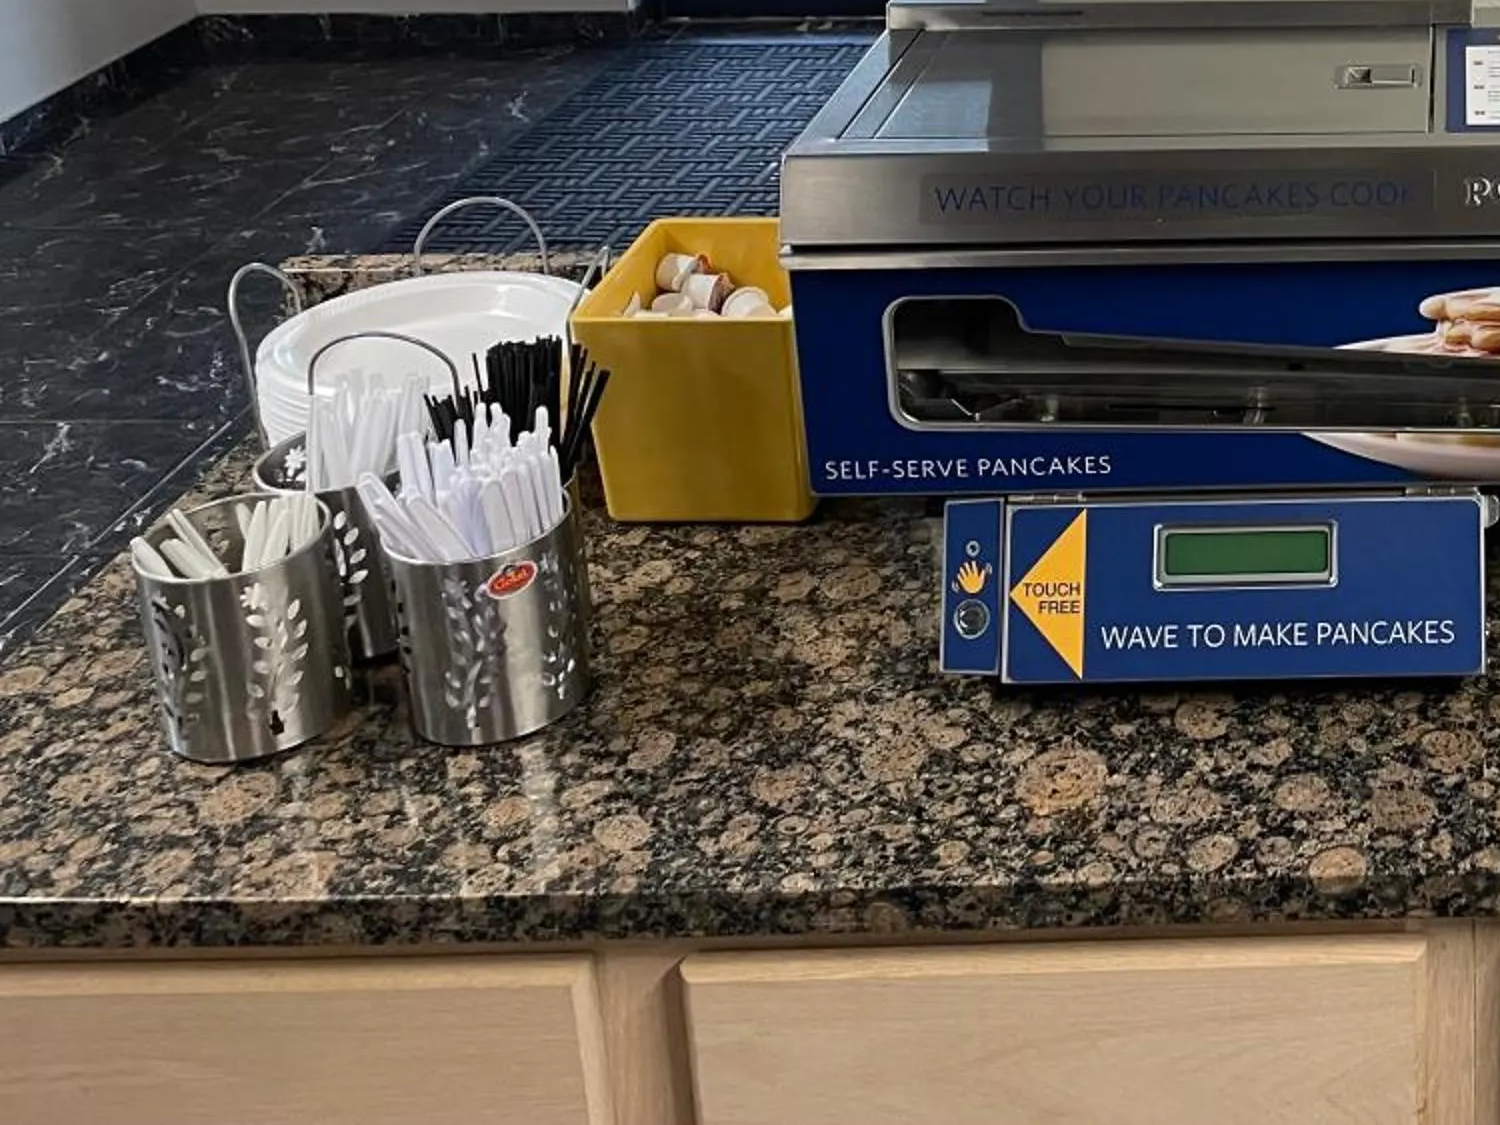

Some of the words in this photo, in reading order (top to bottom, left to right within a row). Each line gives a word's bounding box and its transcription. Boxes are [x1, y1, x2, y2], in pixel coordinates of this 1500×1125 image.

[934, 184, 1049, 213] WATCH
[1063, 183, 1149, 212] YOUR
[1158, 181, 1320, 210] PANCAKES
[824, 459, 969, 480] SELF-SERVE
[977, 456, 1112, 477] PANCAKES
[1023, 582, 1081, 597] TOUCH
[1038, 600, 1081, 614] FREE
[1100, 625, 1179, 650] WAVE
[1187, 624, 1226, 648] TO
[1233, 622, 1309, 647] MAKE
[1316, 619, 1456, 646] PANCAKES
